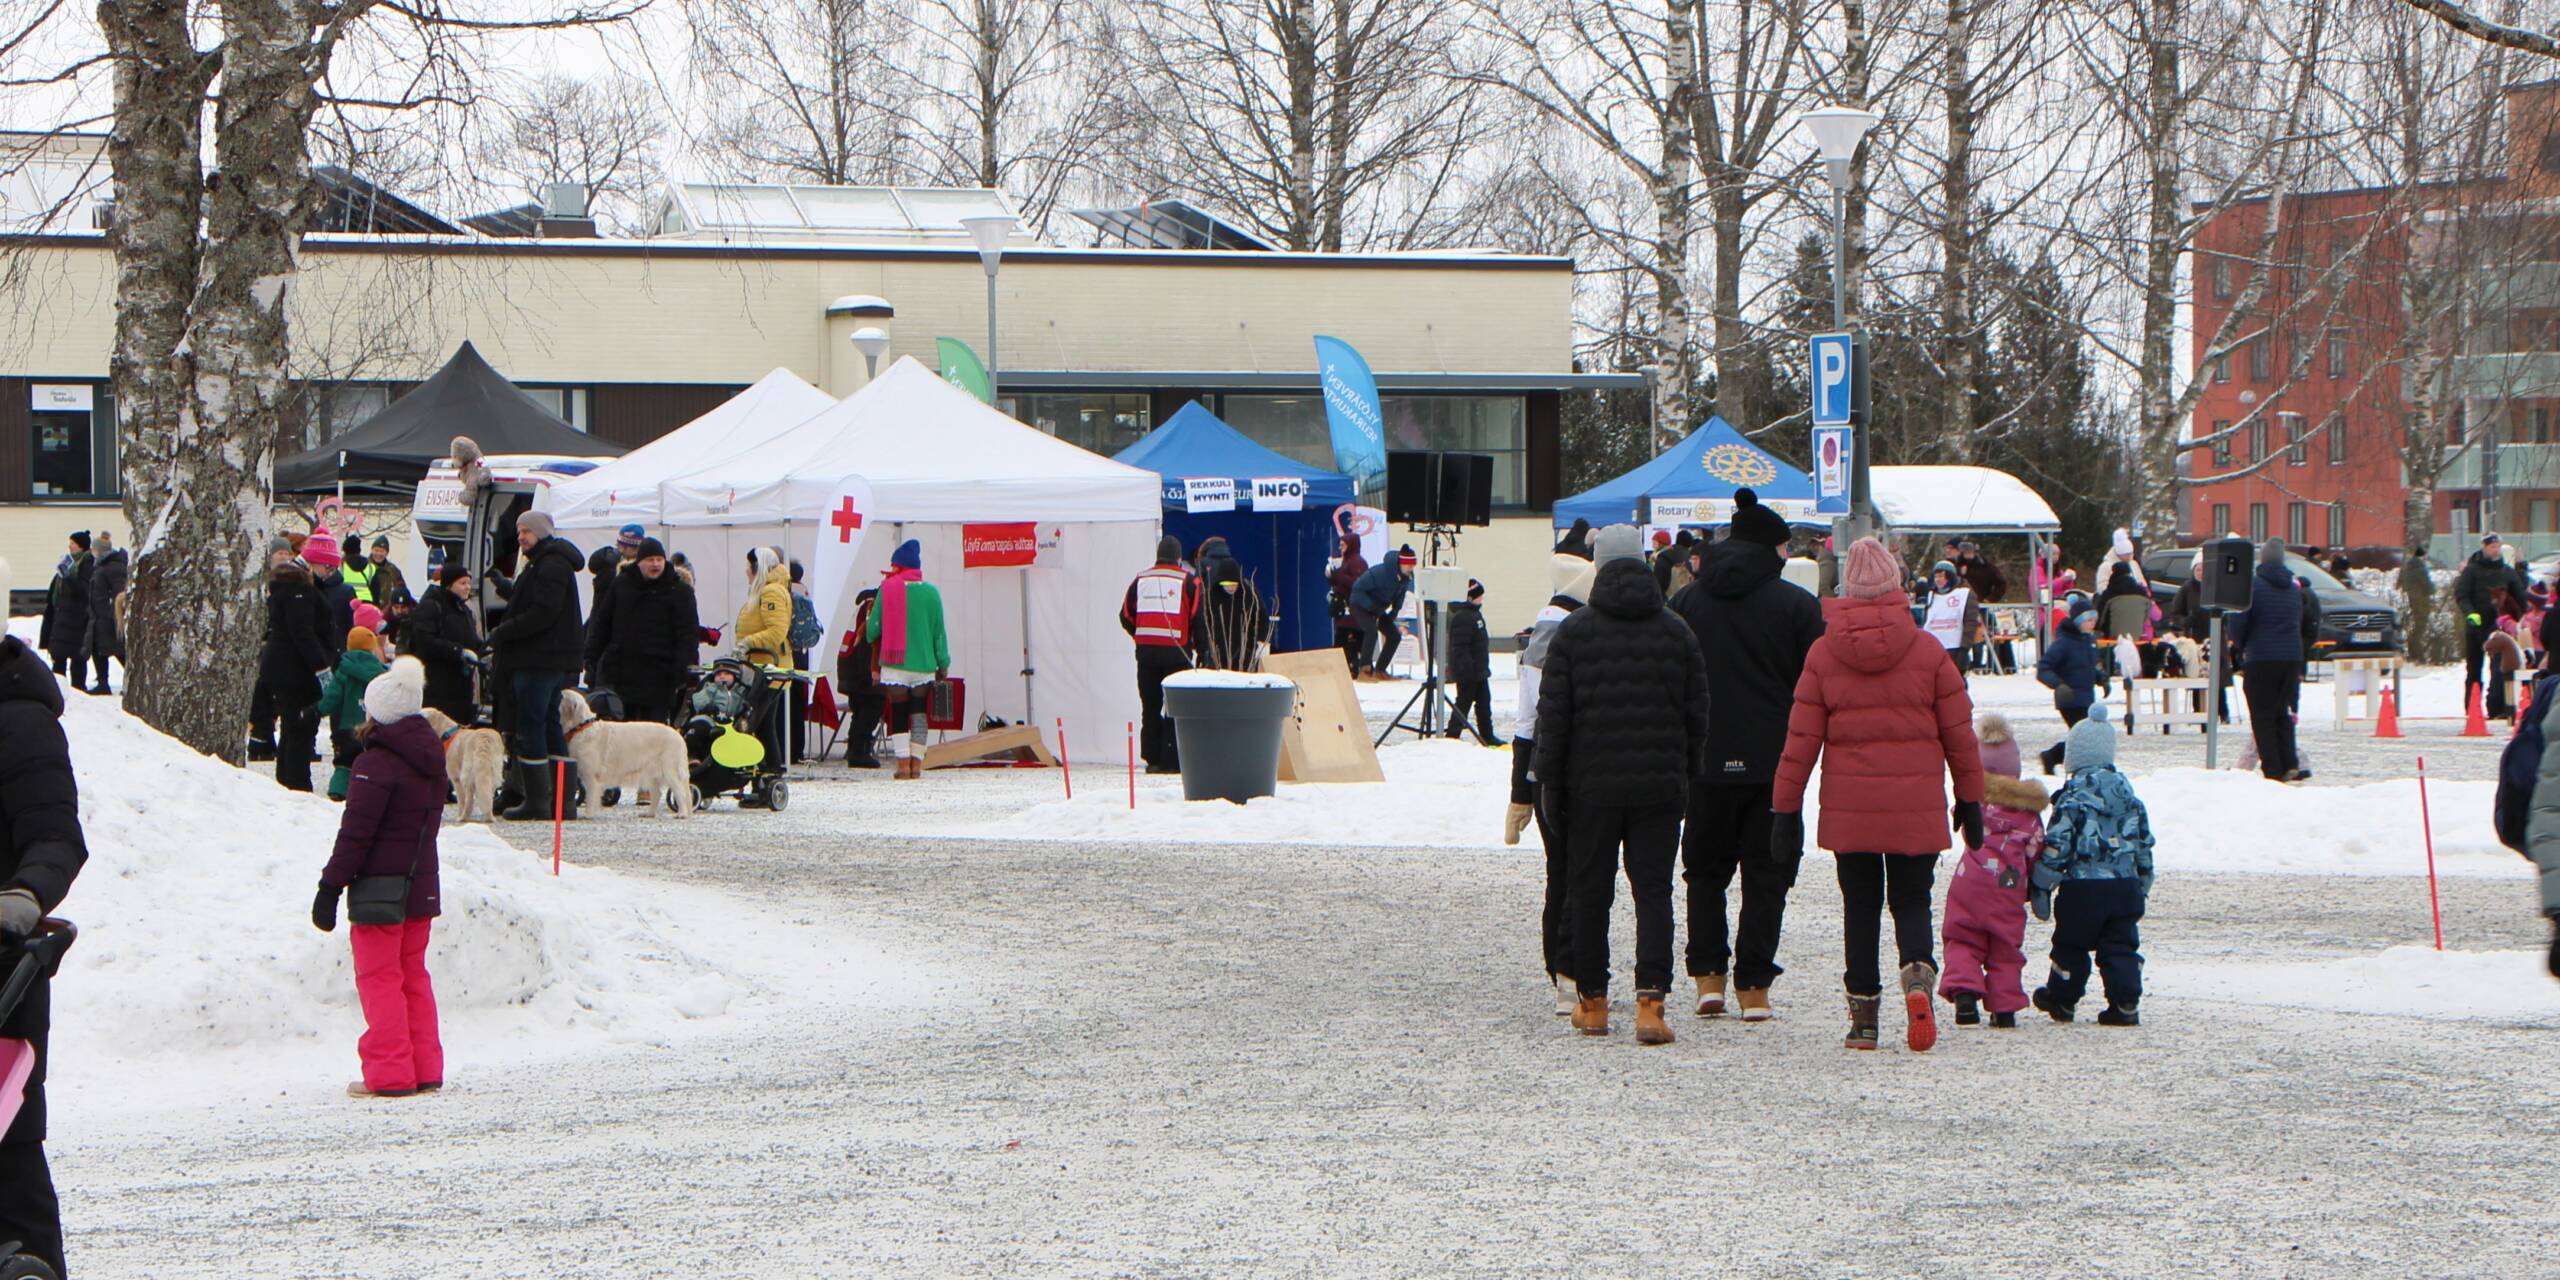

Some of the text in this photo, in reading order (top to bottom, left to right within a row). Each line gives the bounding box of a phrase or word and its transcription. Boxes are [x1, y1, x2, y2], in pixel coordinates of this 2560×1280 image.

[1819, 342, 1846, 417] P
[1193, 492, 1230, 503] MYYNTI
[1258, 483, 1302, 498] INFO
[1657, 505, 1692, 518] Rotary
